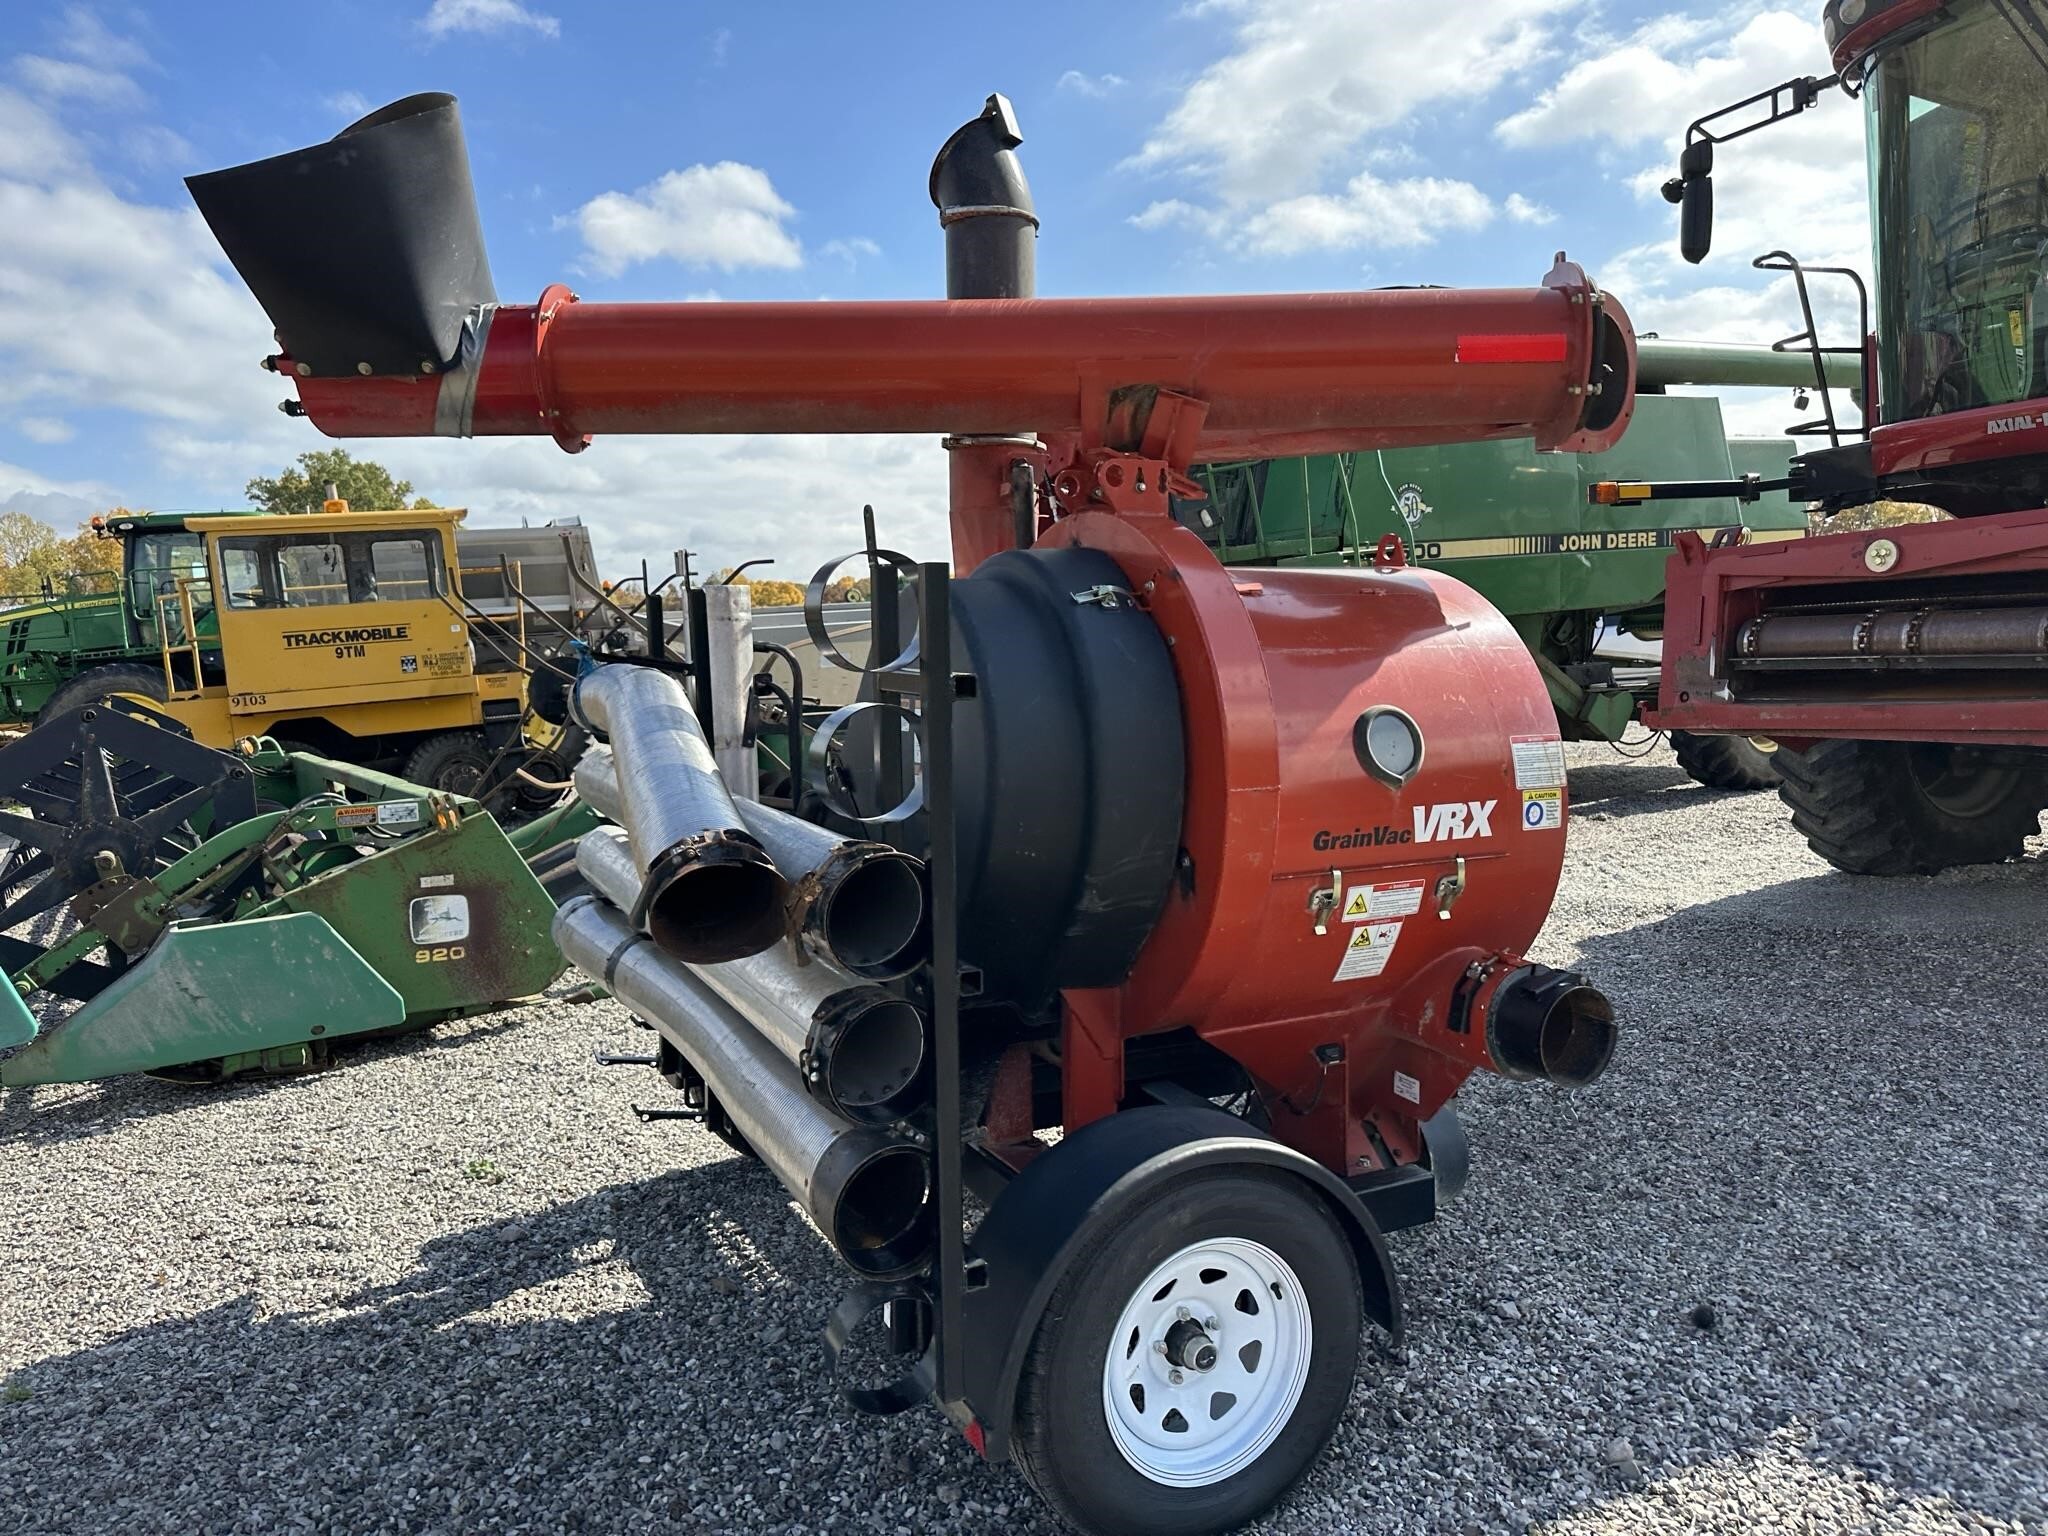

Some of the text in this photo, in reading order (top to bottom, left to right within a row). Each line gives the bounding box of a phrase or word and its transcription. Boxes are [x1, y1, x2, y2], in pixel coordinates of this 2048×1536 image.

[1403, 495, 1418, 519] 50
[1559, 531, 1657, 551] JOHN DEERE
[282, 626, 409, 647] TRACKMOBILE
[335, 645, 366, 659] 9TM
[231, 694, 267, 707] 9103
[344, 807, 376, 816] WARNING
[1313, 799, 1498, 851] GrainVac VRX
[415, 946, 466, 964] 920
